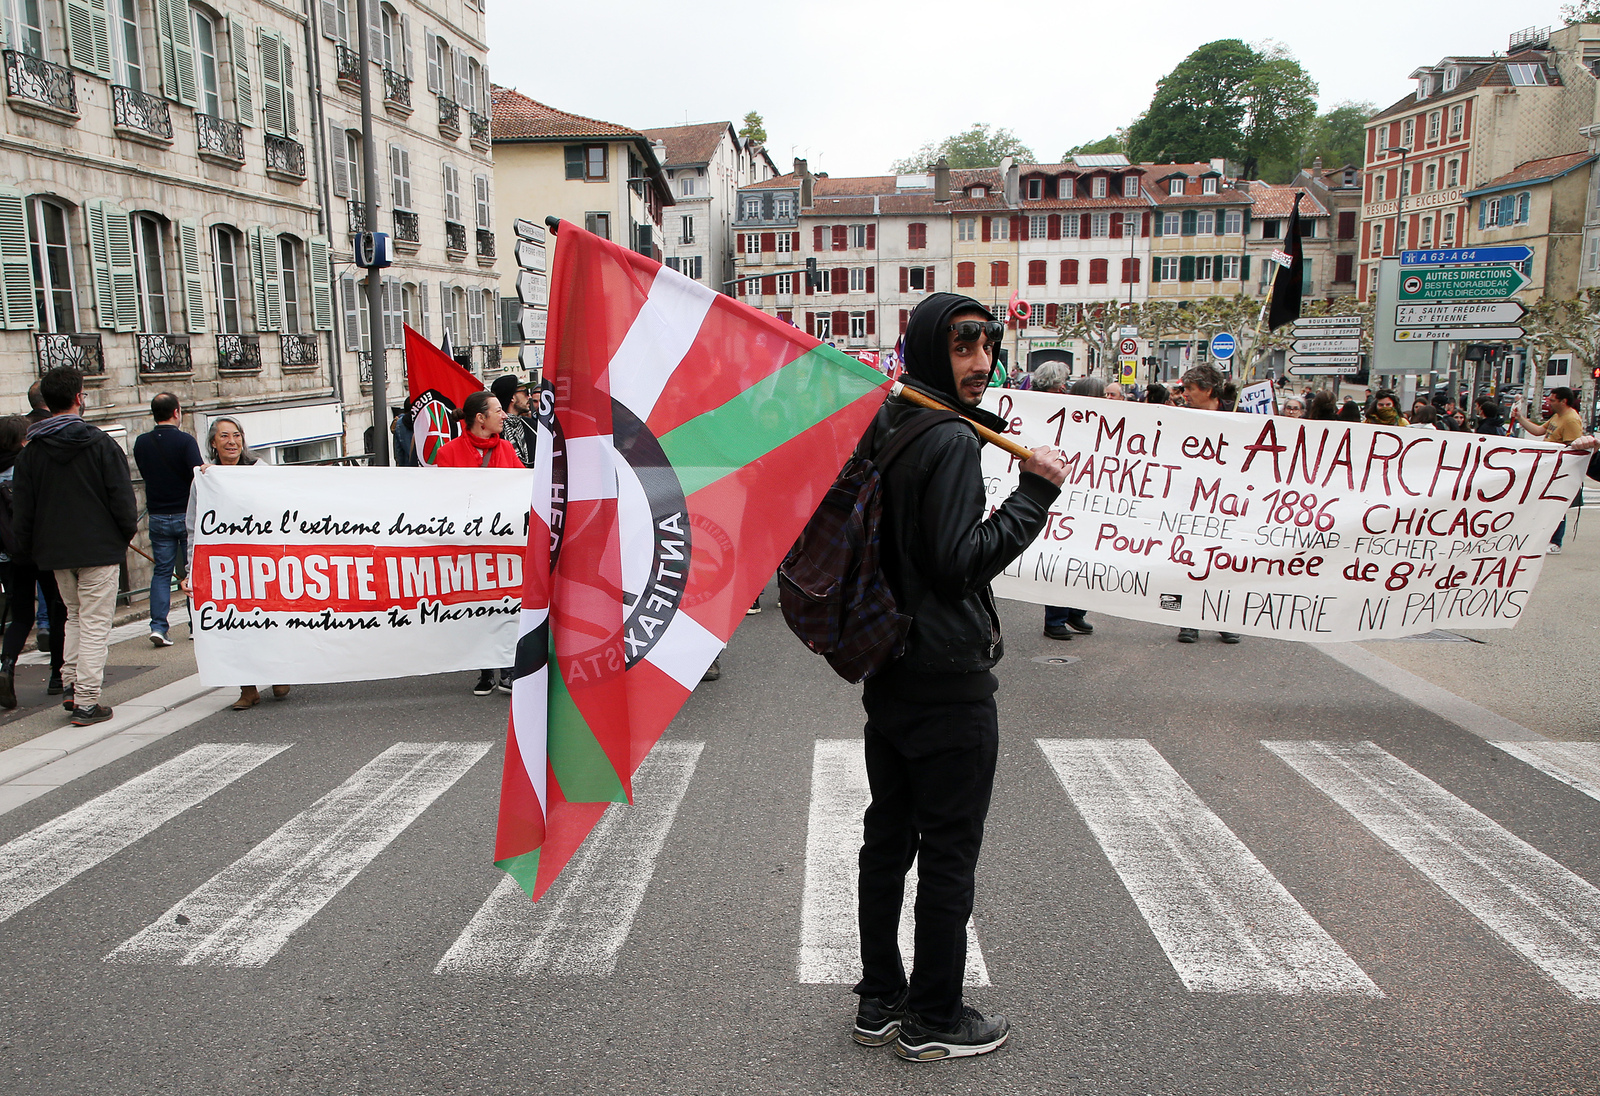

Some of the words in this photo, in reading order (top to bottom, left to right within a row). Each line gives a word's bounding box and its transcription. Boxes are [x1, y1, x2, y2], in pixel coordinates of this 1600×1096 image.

[1420, 253, 1427, 261] A
[1461, 251, 1476, 260] 64
[1425, 271, 1459, 281] AUTRES
[1460, 269, 1512, 280] DIRECTIONS
[1425, 281, 1452, 289] BESTE
[1453, 279, 1509, 288] NORABIDEAK
[1424, 289, 1454, 297] AUTAS
[1454, 288, 1507, 297] DIRECCIONS
[1400, 307, 1417, 315] Z.A.
[1422, 306, 1448, 314] SAINT
[1452, 305, 1497, 313] FRÉDÉRIC
[1430, 314, 1468, 322] ÉTIENNE
[1123, 342, 1134, 351] 30
[1244, 388, 1266, 402] VEUT
[998, 394, 1023, 436] le
[1095, 415, 1163, 458] Mai
[1182, 433, 1230, 465] est
[1190, 477, 1255, 518] Mai
[1262, 488, 1340, 532] 1886
[200, 509, 273, 535] Contre
[279, 509, 381, 535] l'extreme
[388, 512, 455, 537] droite
[463, 515, 483, 537] et
[489, 511, 514, 537] la
[1158, 510, 1237, 541] NEEBE
[1254, 525, 1341, 549] SCHWAB
[1448, 533, 1530, 560] PARSON
[1095, 522, 1163, 556] Pour
[1168, 534, 1196, 567] la
[1343, 557, 1379, 583] de
[1434, 564, 1468, 590] de
[1471, 553, 1542, 589] TAF
[208, 554, 377, 601] RIPOSTE
[1064, 557, 1150, 597] PARDON
[200, 605, 279, 631] Eskuin
[285, 610, 381, 631] muturra
[387, 608, 412, 628] ta
[1402, 587, 1529, 628] PATRONS
